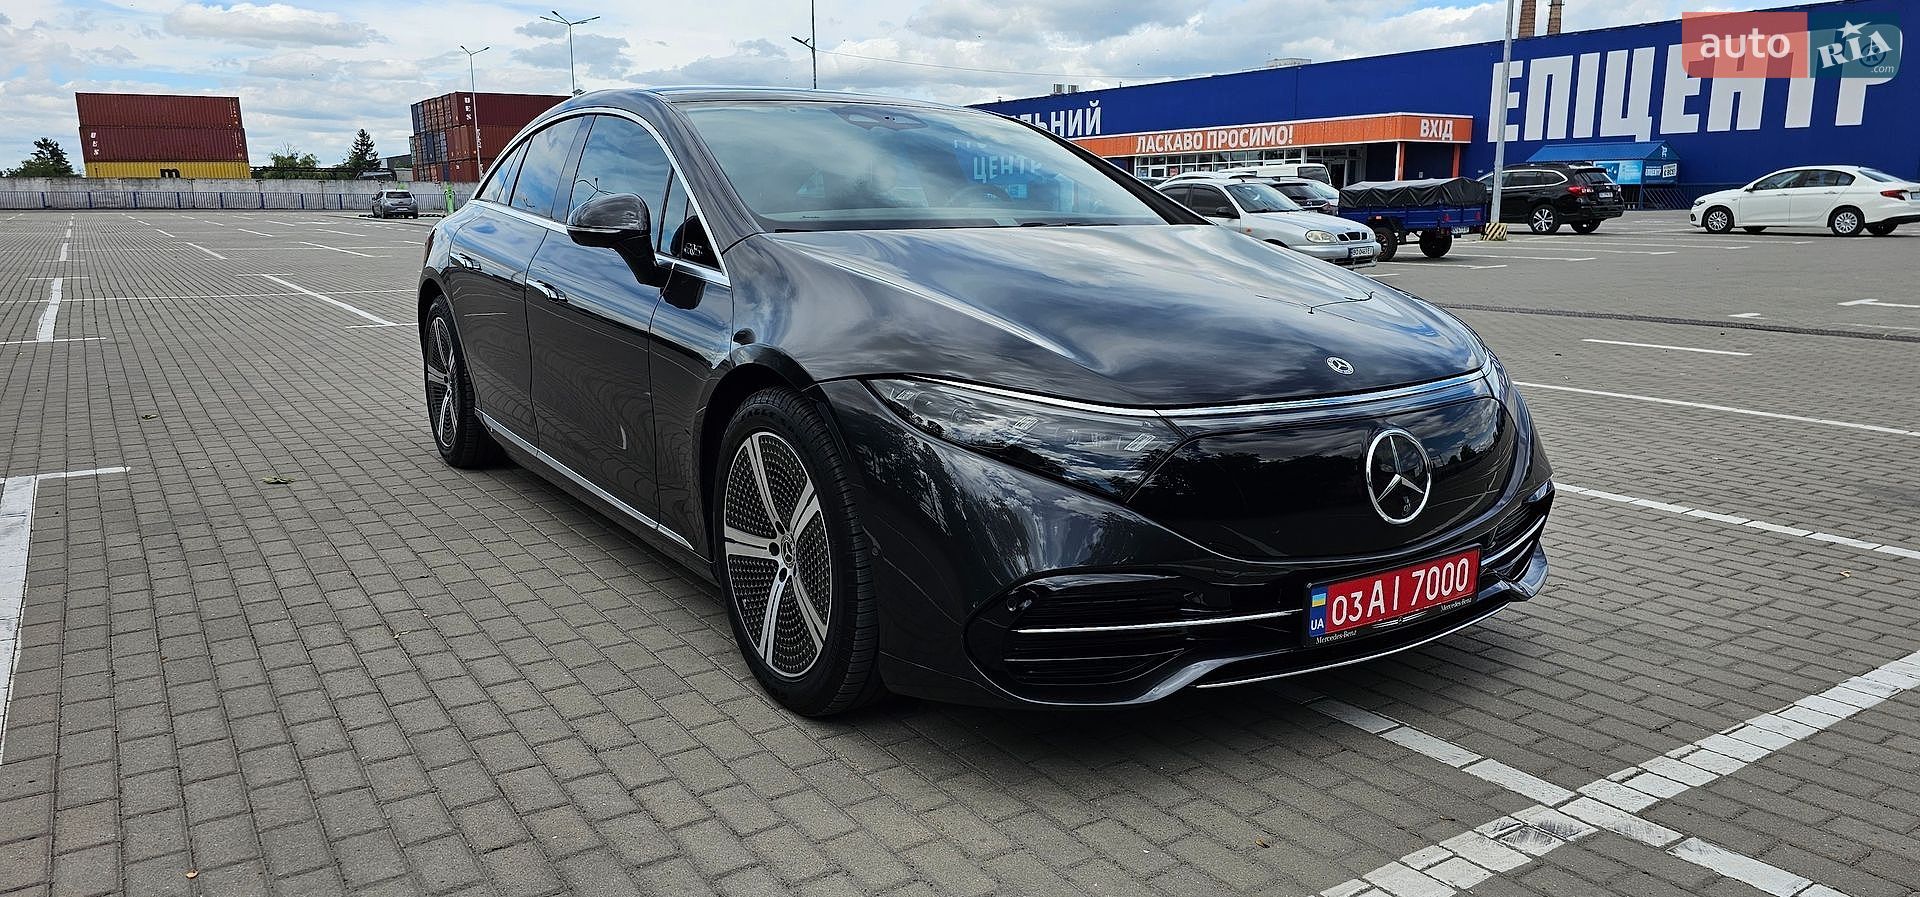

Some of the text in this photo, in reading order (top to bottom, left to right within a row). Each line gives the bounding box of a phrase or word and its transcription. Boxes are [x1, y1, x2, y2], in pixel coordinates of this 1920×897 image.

[1136, 125, 1293, 153] ЛАСКАВО ПРОСИМО!
[1420, 119, 1453, 141] ВХІД
[1410, 558, 1469, 607] 7000
[1310, 618, 1325, 631] UA
[1315, 629, 1357, 644] Mercedes-Benz
